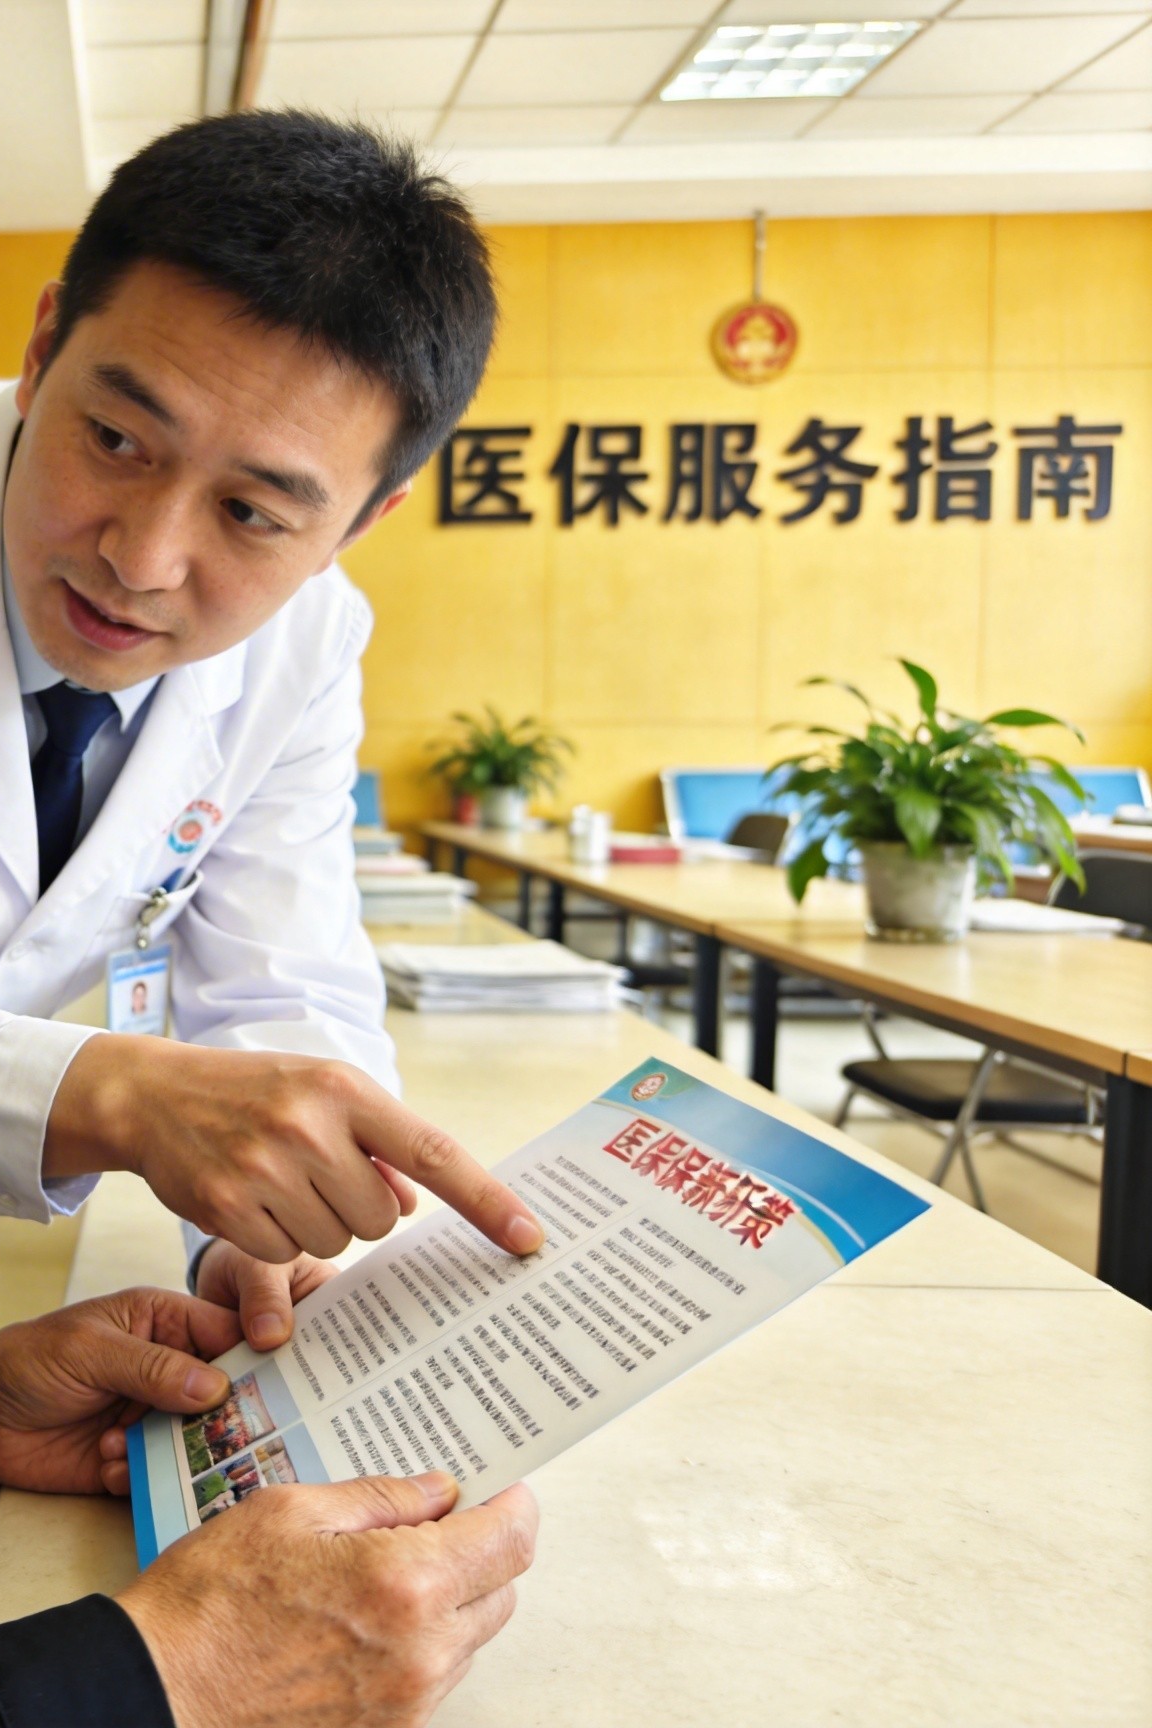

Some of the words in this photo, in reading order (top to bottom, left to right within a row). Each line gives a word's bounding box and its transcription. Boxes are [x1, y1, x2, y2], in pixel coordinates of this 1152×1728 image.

[438, 415, 1123, 525] 医保服务指南
